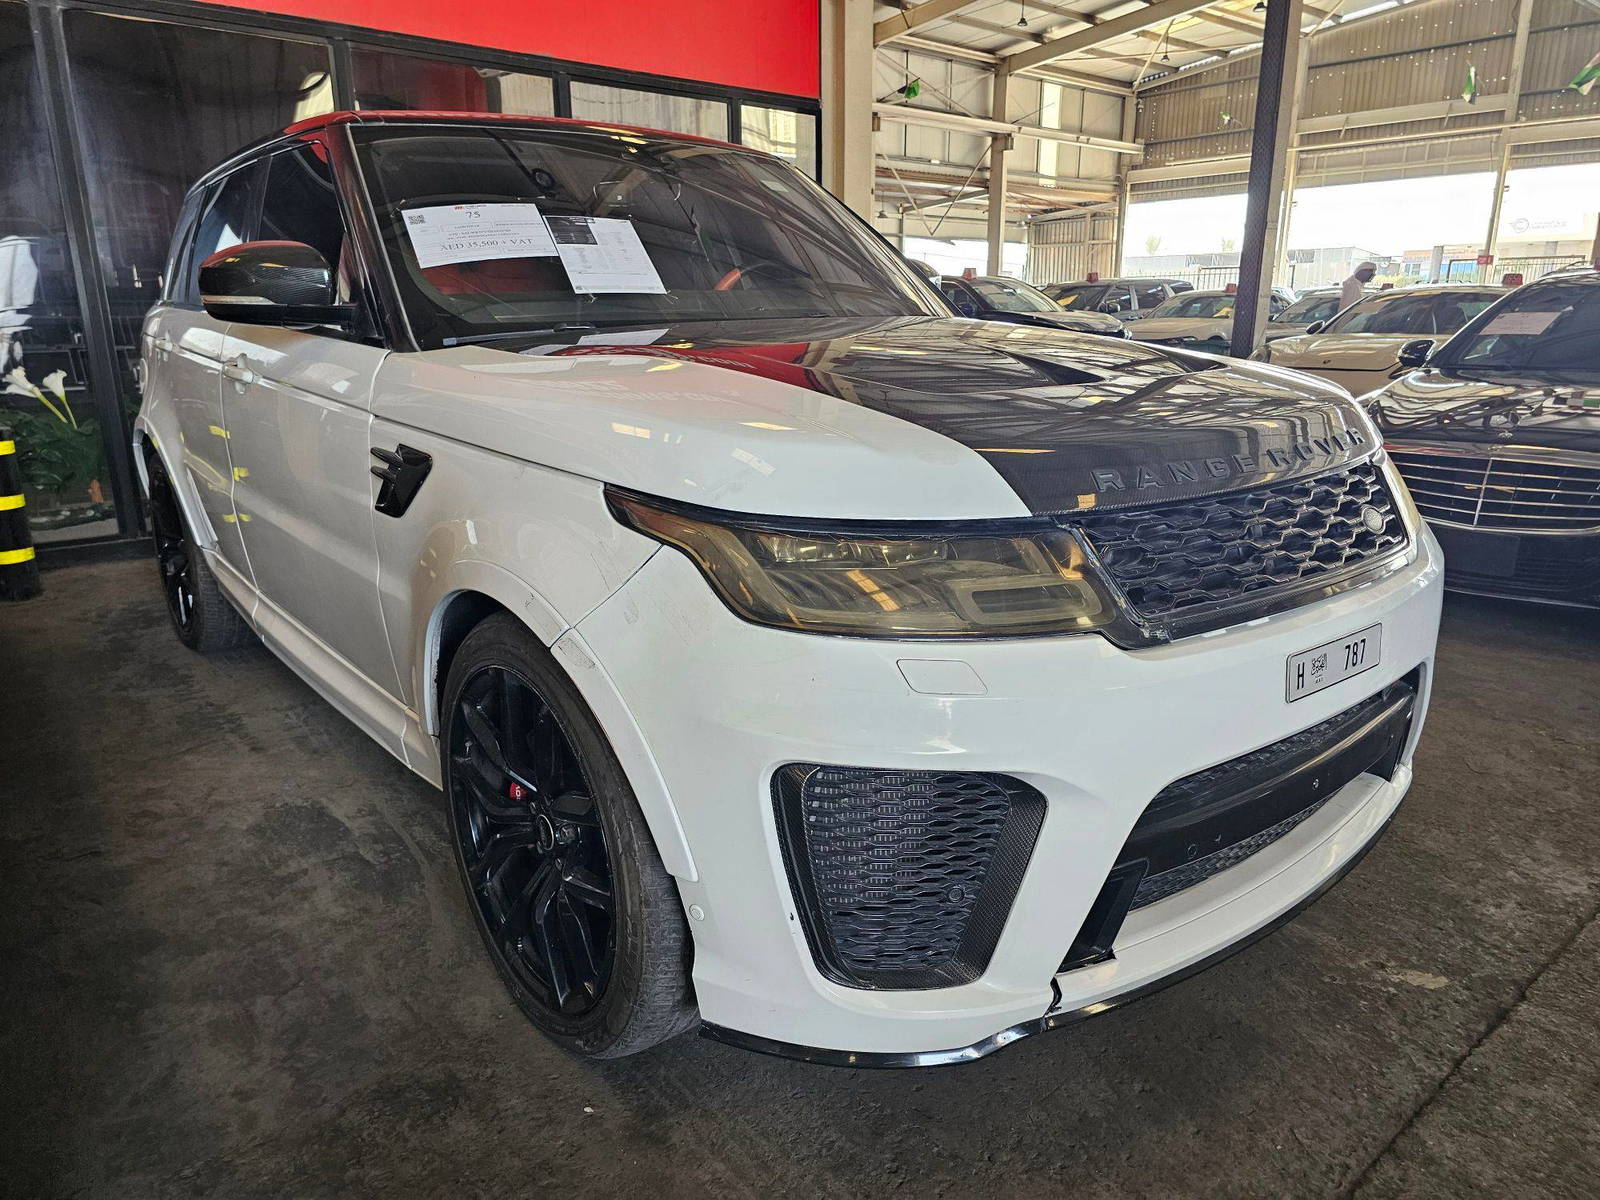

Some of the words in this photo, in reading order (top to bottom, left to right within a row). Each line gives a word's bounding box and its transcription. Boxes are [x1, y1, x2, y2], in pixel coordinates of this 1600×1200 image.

[440, 242, 464, 251] AED
[510, 238, 533, 247] VAT
[1089, 454, 1259, 493] RANGE
[1266, 427, 1365, 467] ROVER
[1297, 662, 1305, 689] H
[1345, 638, 1366, 670] 787
